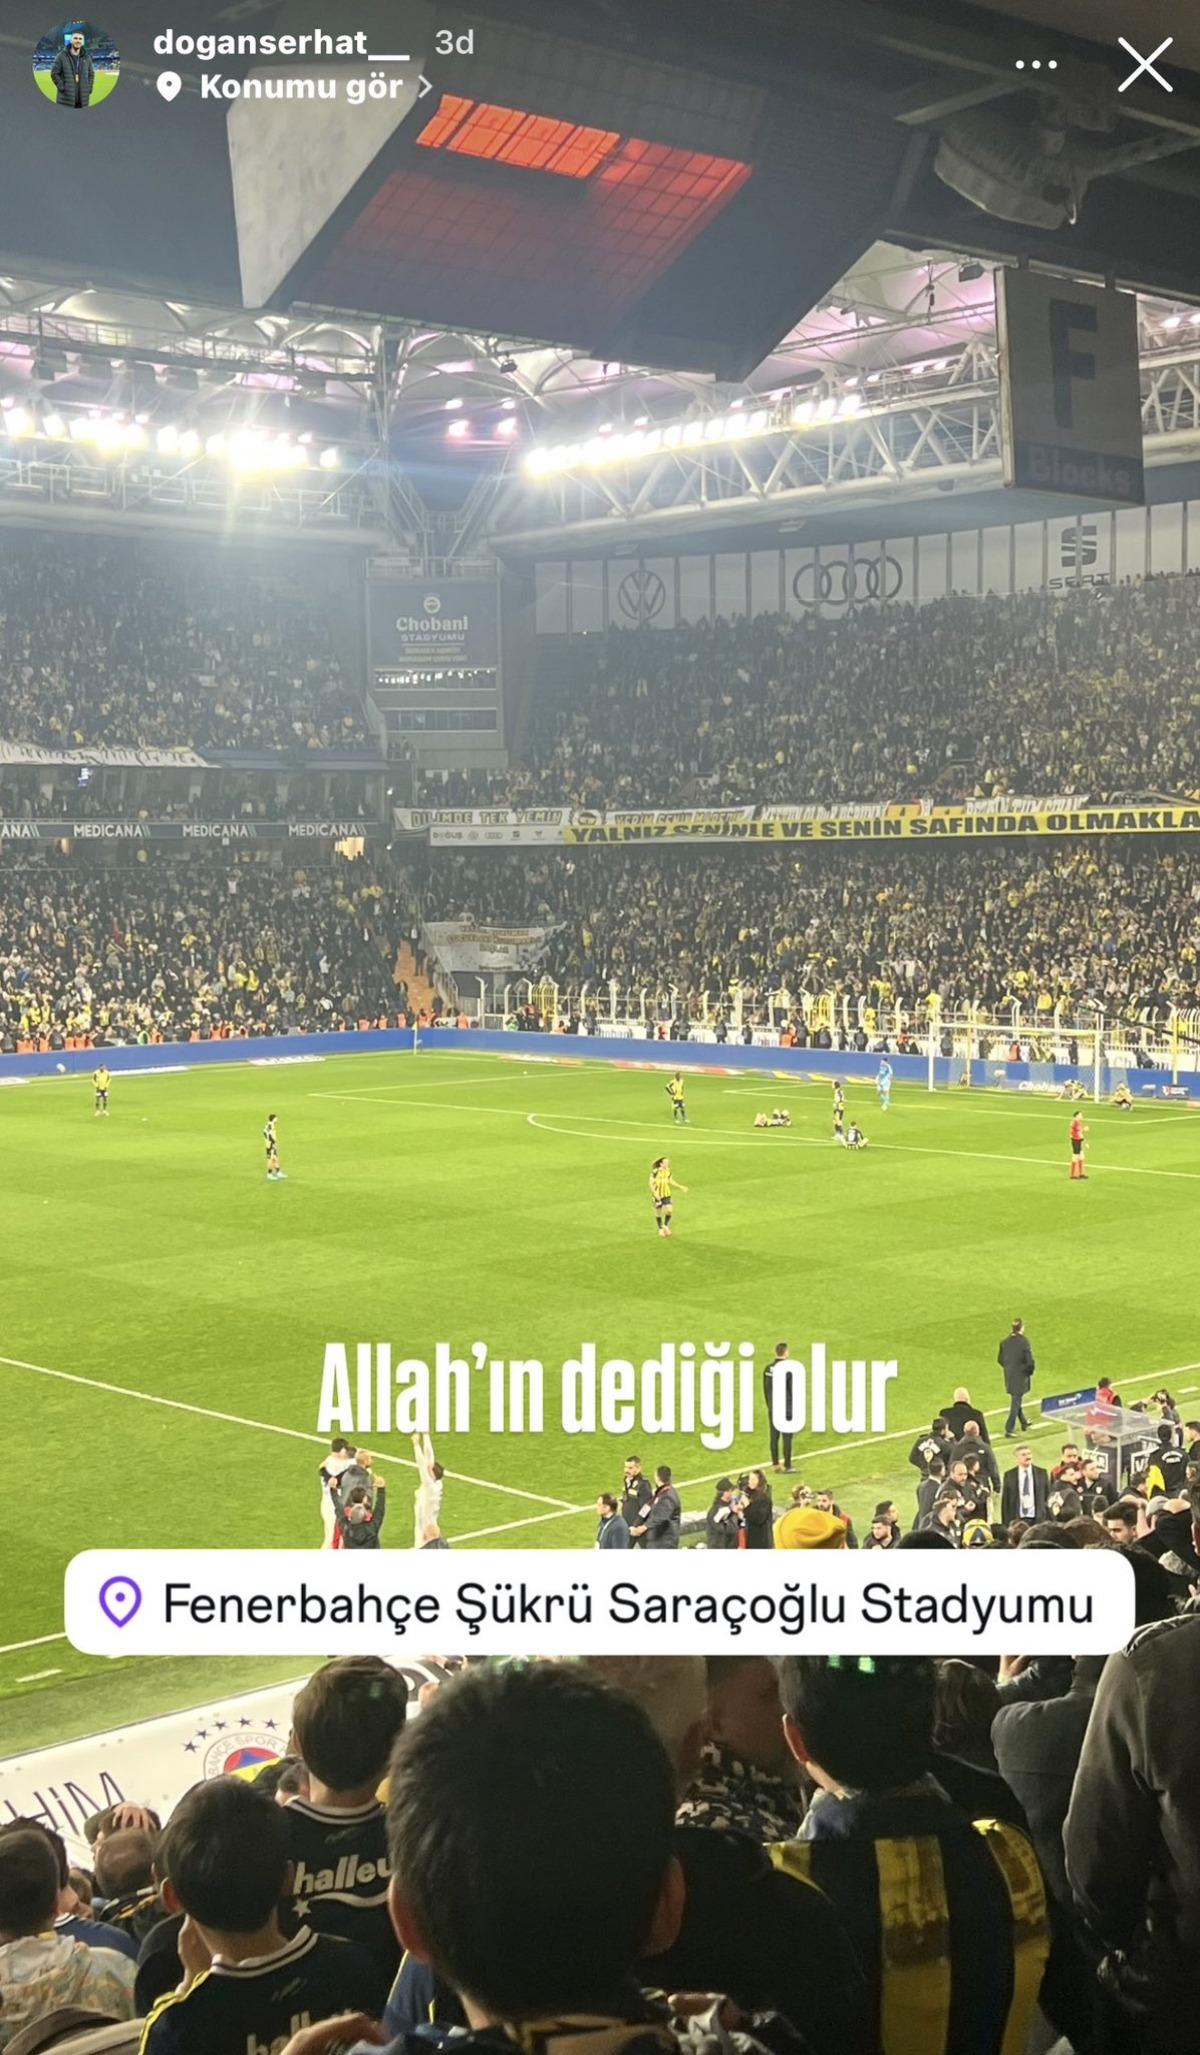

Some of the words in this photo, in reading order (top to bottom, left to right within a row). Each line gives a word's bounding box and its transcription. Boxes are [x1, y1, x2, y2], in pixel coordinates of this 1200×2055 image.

[1049, 297, 1098, 430] F
[1029, 446, 1131, 496] Blocks
[1049, 573, 1111, 590] SEAT
[396, 615, 469, 632] Chobani
[401, 633, 465, 642] STADYUMU
[479, 810, 510, 825] TEK
[73, 824, 144, 838] MEDICANA
[183, 824, 249, 838] MEDICANA
[288, 823, 359, 838] MEDICANA
[570, 826, 667, 842] YALNIZ
[781, 822, 814, 838] VE
[910, 814, 1039, 835] SAFINDA
